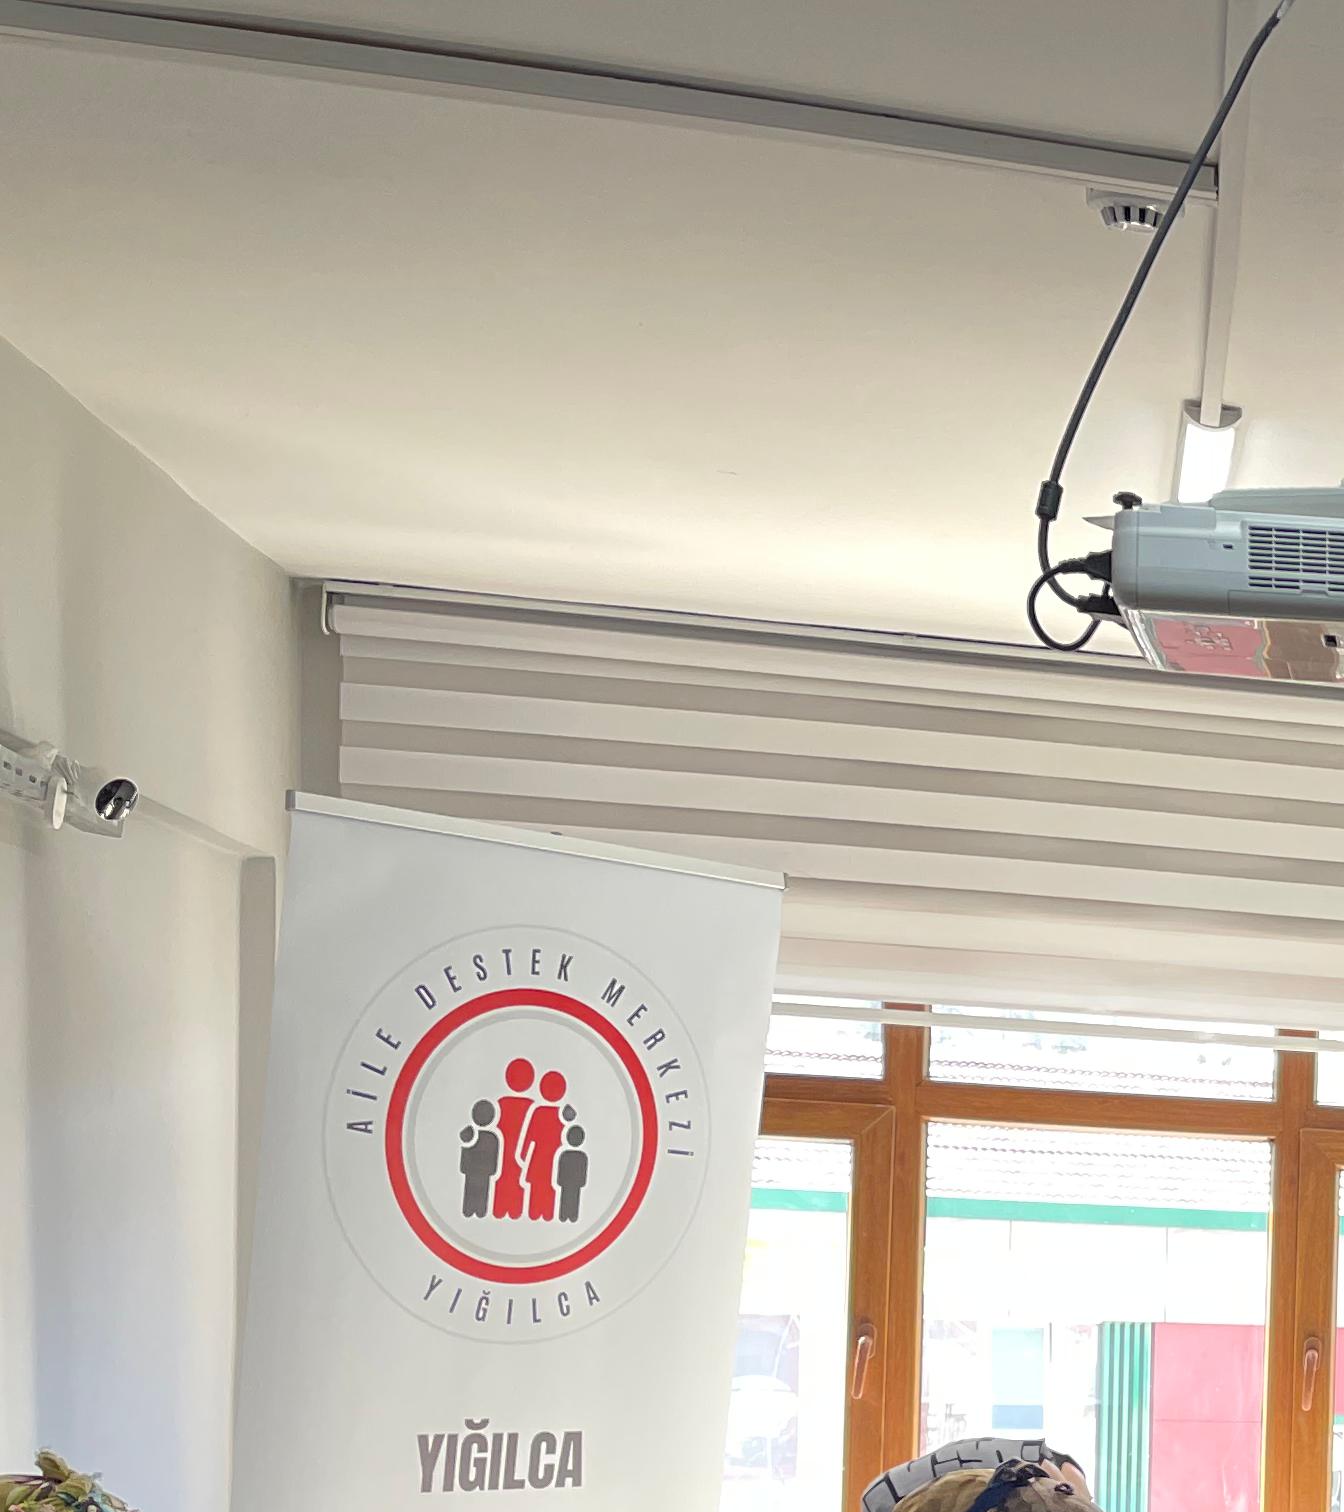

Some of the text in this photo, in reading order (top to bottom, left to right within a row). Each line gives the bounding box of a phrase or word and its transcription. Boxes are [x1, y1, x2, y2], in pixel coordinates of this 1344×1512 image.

[346, 948, 695, 1158] AİLE DESTEK MERKEZİ
[423, 1273, 602, 1326] YIĞILCA
[416, 1417, 584, 1494] YIĞILCA
